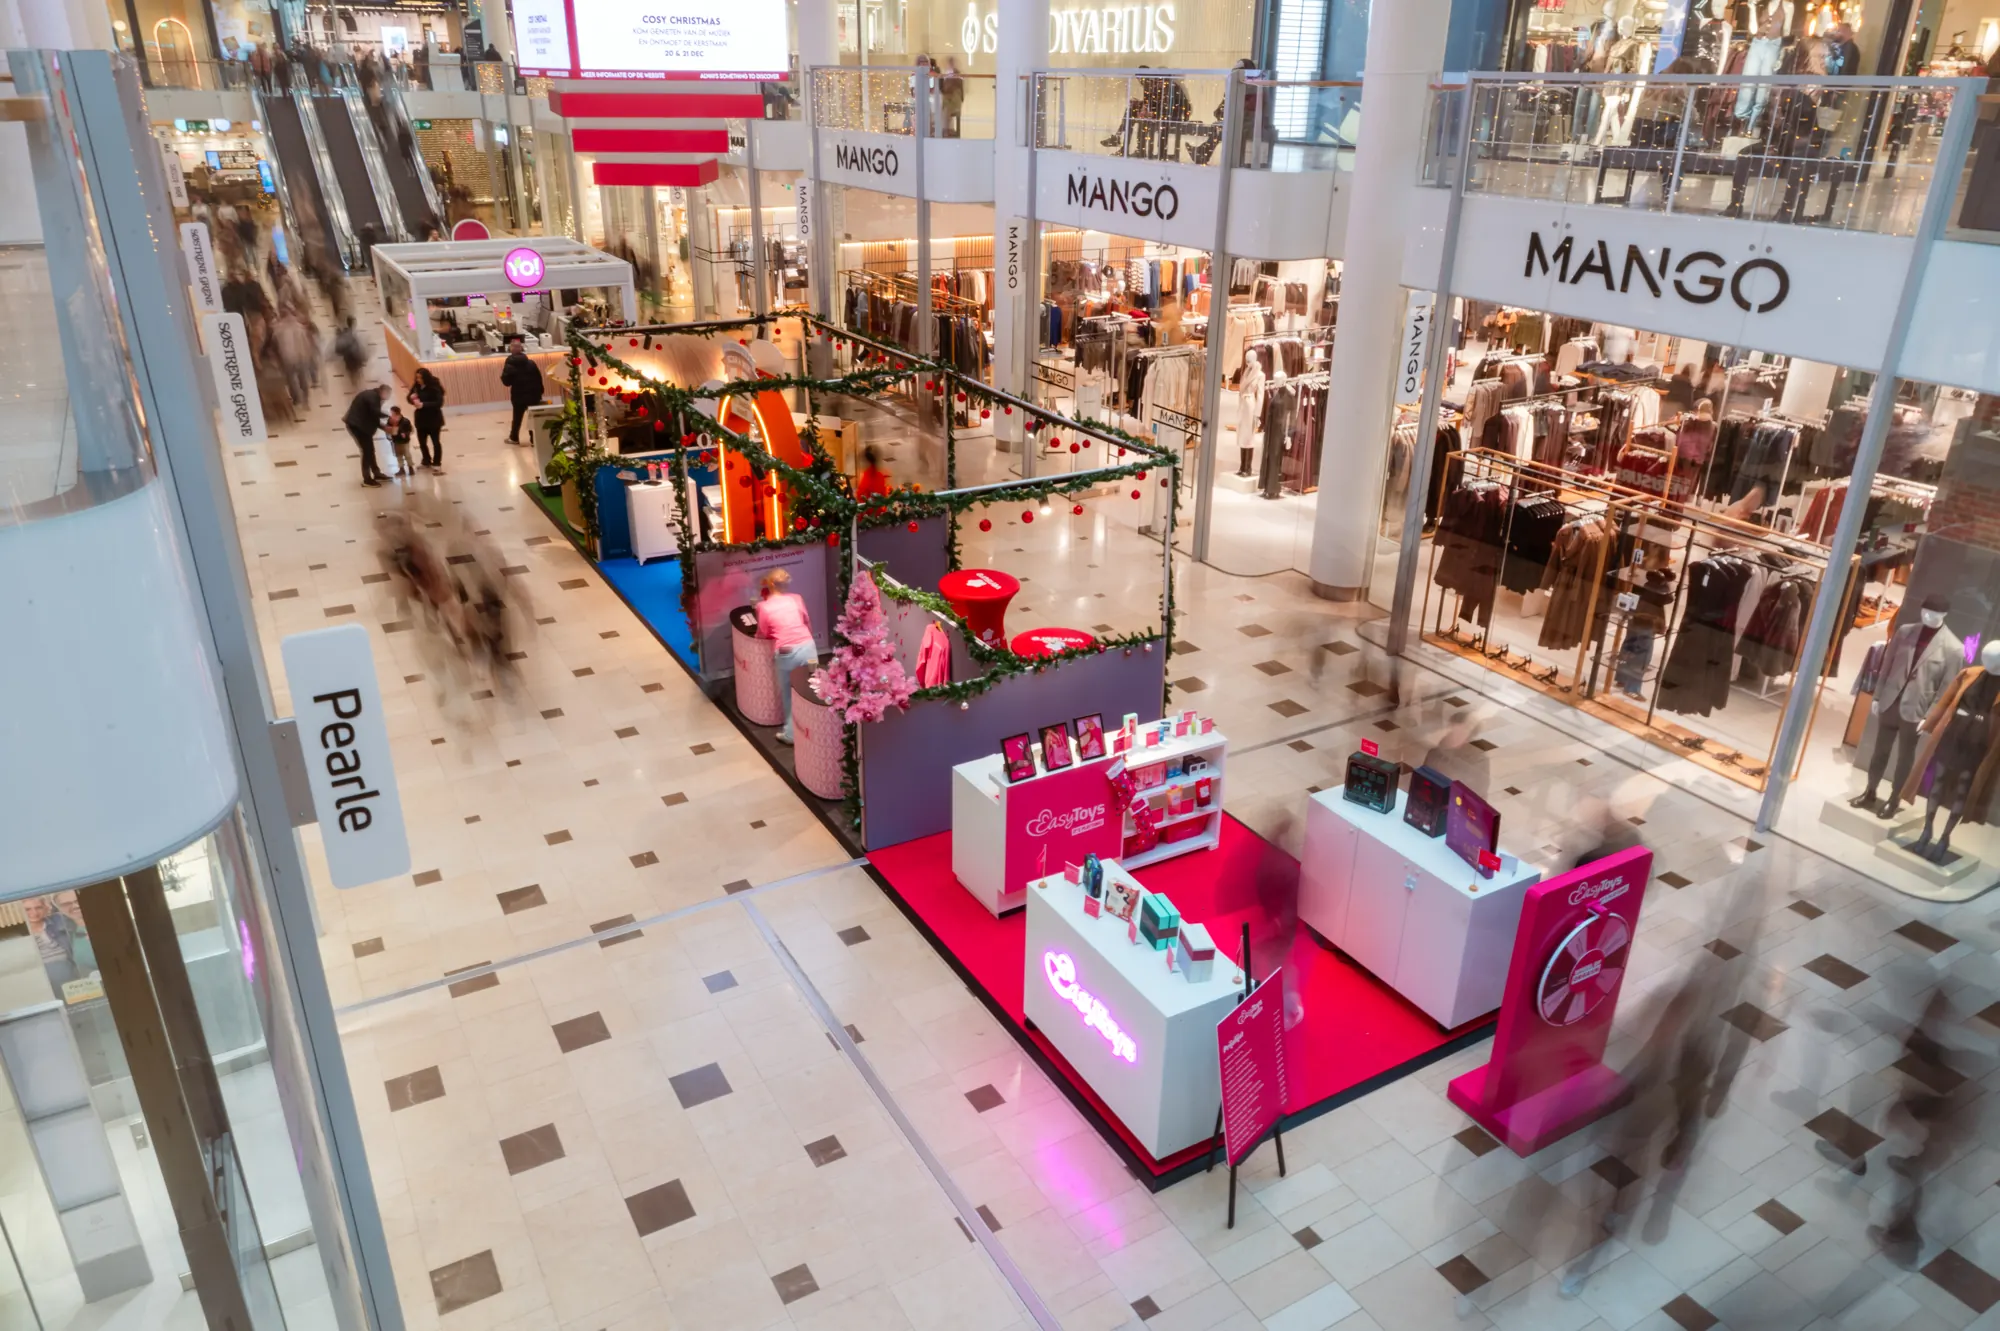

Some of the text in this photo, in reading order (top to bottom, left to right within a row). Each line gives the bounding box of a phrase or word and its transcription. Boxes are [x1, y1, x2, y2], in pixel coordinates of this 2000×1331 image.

[642, 15, 721, 26] COSY CHRISTMAS
[983, 5, 1176, 54] SDIVARIUS
[836, 145, 899, 177] MANGO
[799, 185, 809, 235] MANGO
[1068, 172, 1179, 221] MANGO
[1008, 226, 1018, 290] MANGO
[1523, 231, 1791, 314] MANGO
[198, 275, 214, 306] GRENE
[1404, 304, 1427, 395] MANGO
[218, 322, 253, 437] SØSTRENE GRENE
[1159, 408, 1199, 433] MANGO
[312, 688, 381, 834] Pearle
